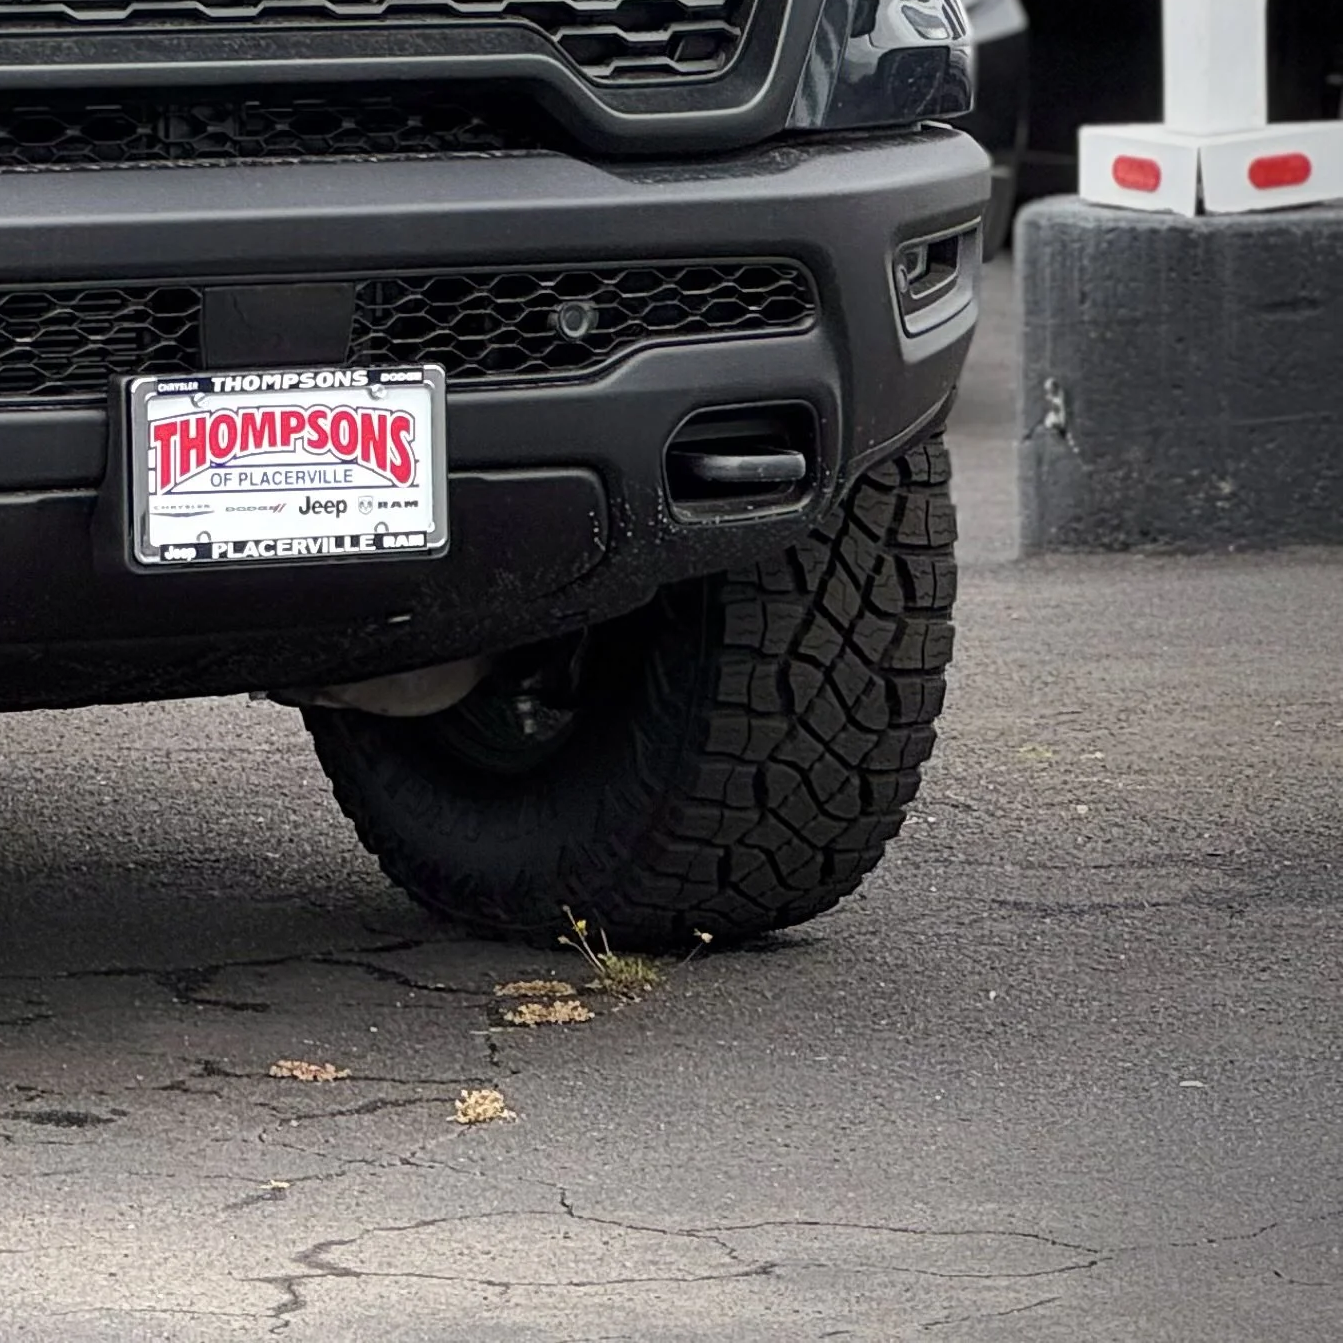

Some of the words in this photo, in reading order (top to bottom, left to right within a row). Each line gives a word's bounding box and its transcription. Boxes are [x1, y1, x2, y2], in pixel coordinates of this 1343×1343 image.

[211, 370, 369, 393] THOMPSONS
[153, 409, 413, 490] THOMPSONS
[210, 472, 233, 488] OF
[238, 468, 354, 486] PLACERVILLE
[298, 496, 348, 518] Jeep
[377, 499, 419, 509] RAM
[164, 545, 197, 561] Jeep
[211, 534, 377, 559] PLACERVILLE
[382, 533, 425, 549] RAM
